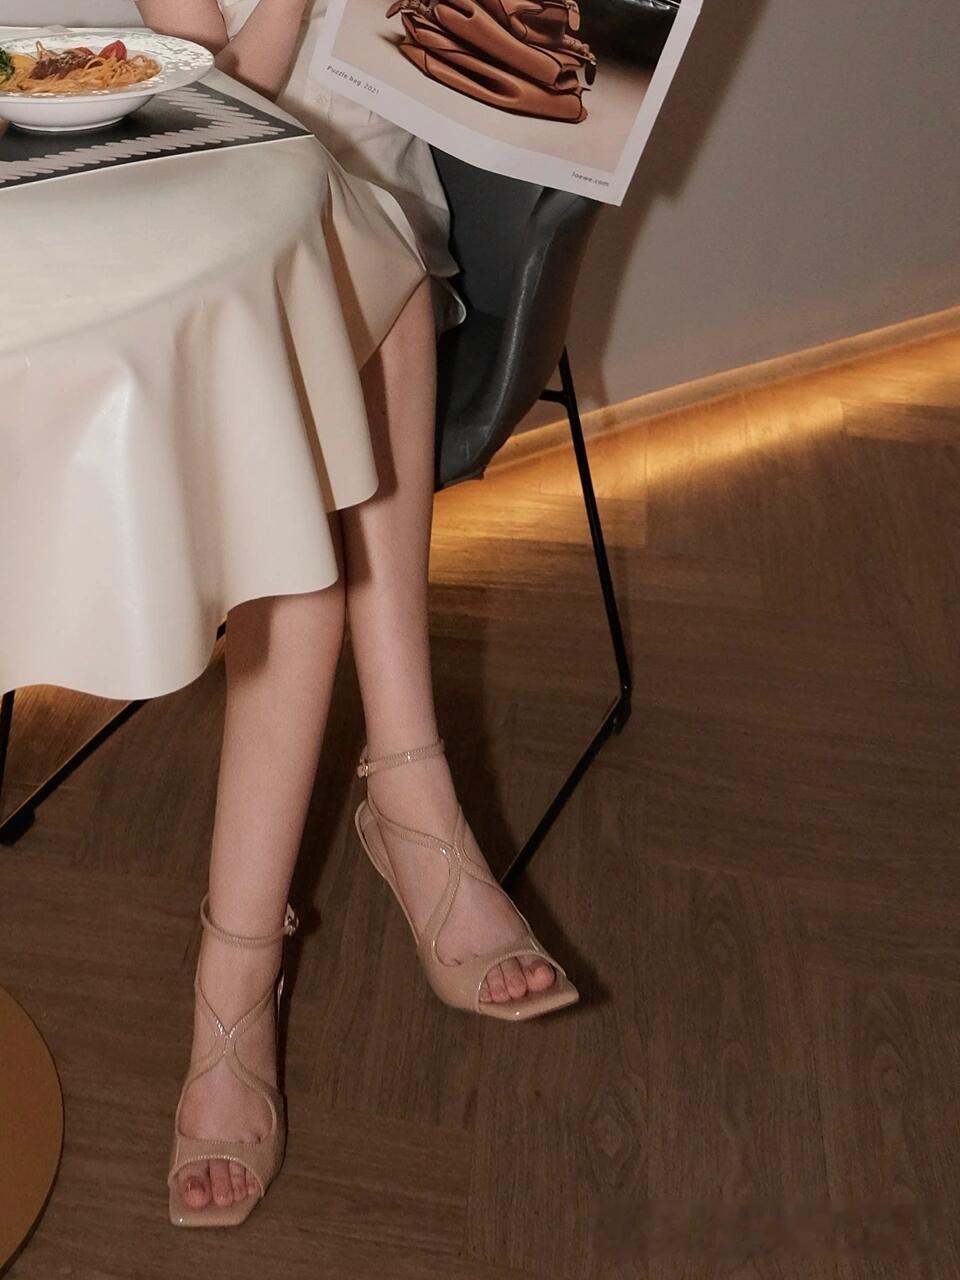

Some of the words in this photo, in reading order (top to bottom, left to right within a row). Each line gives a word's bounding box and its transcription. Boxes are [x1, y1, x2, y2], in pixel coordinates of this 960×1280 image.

[326, 65, 348, 78] Puzzle
[349, 75, 362, 87] bag
[363, 83, 380, 95] 2021
[571, 170, 609, 186] loewe.com
